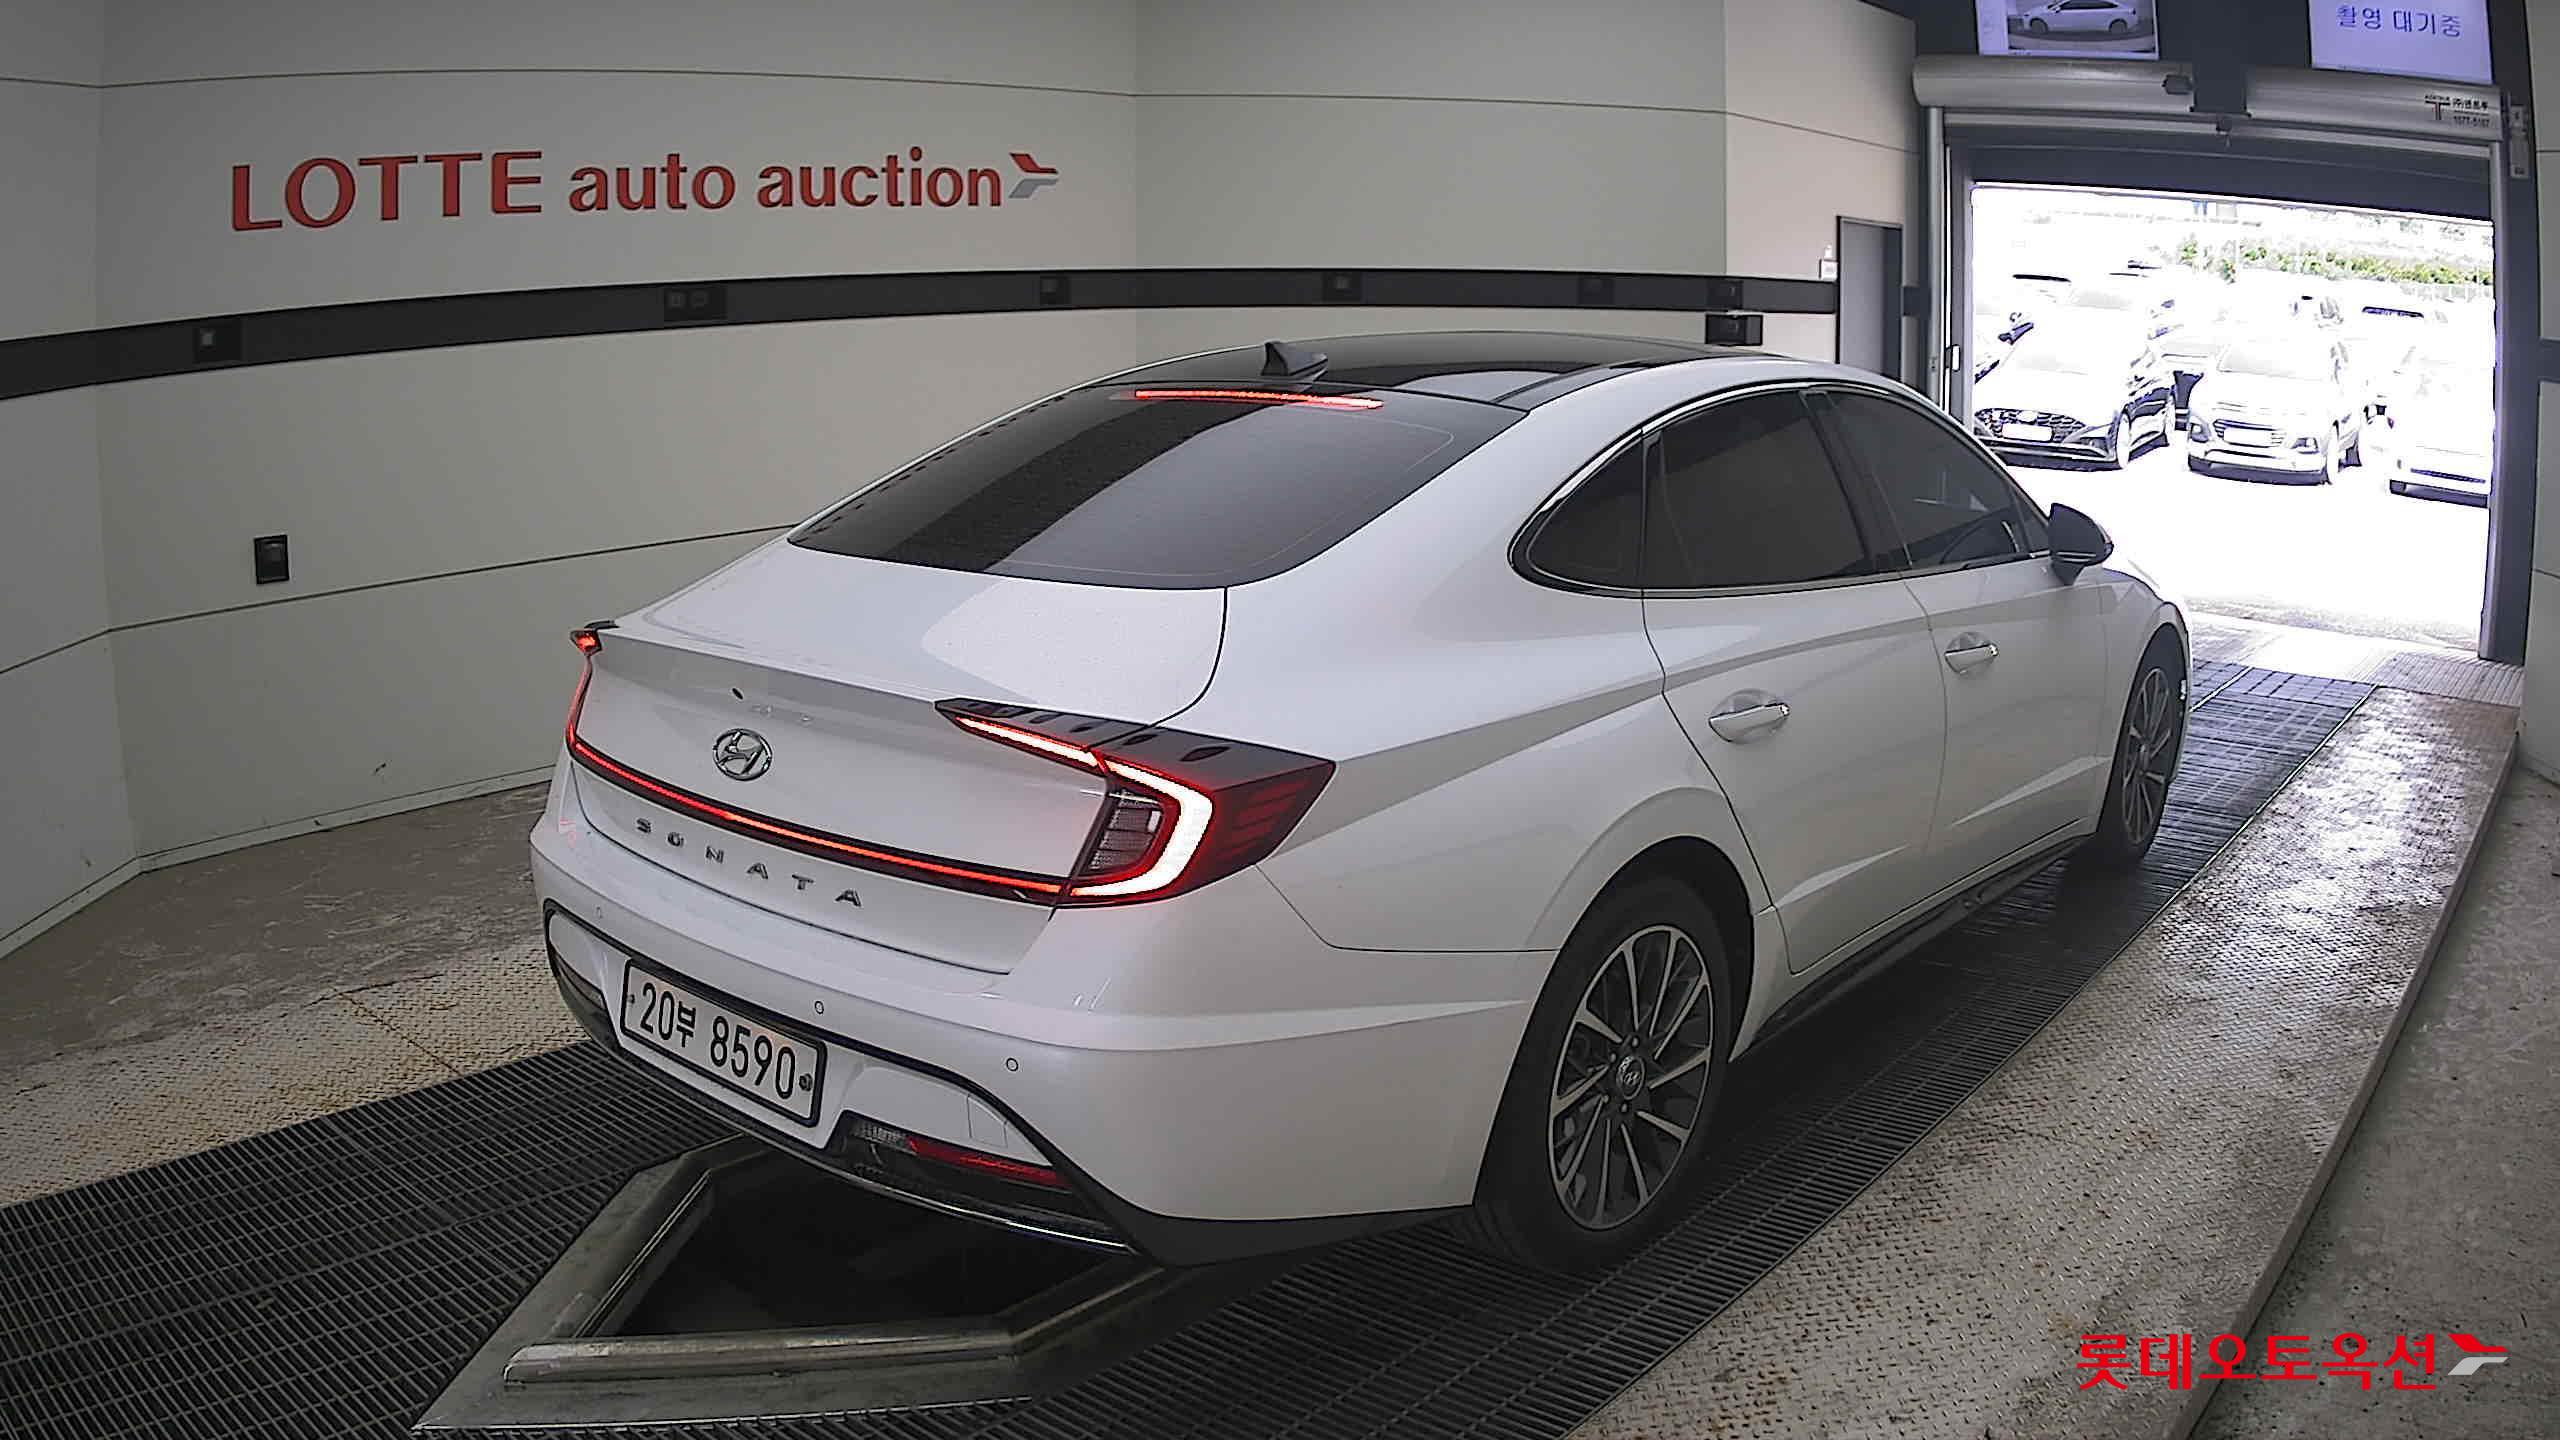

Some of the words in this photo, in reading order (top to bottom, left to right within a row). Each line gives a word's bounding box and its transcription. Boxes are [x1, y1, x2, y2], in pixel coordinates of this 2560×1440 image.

[2338, 5, 2382, 30] 촬영
[2392, 10, 2462, 38] 대기중
[232, 150, 542, 231] LOTTE
[568, 153, 735, 211] auto
[757, 147, 1001, 208] auction
[636, 817, 862, 907] SONATA
[640, 982, 696, 1048] 20부
[710, 1015, 796, 1099] 8590
